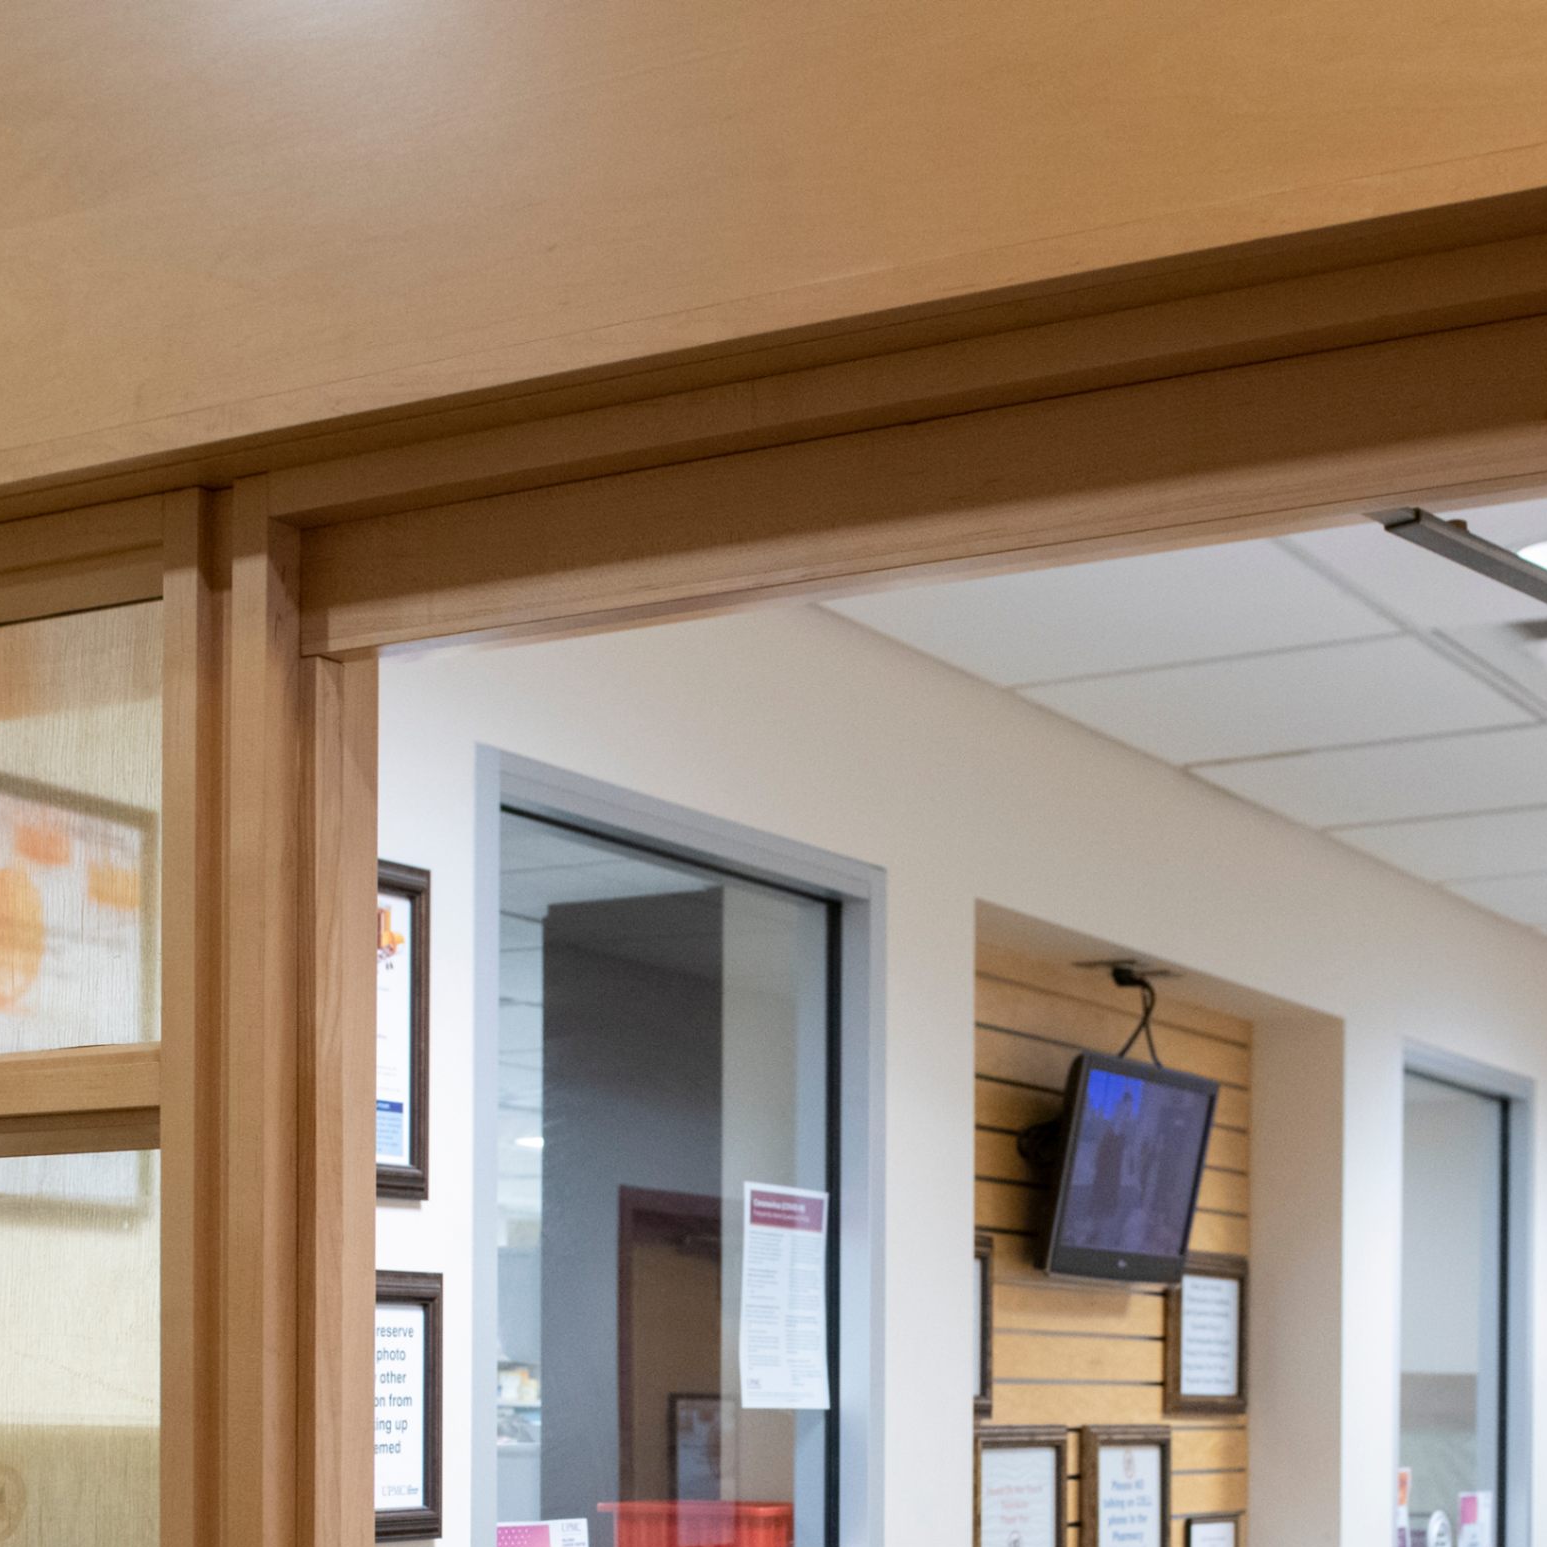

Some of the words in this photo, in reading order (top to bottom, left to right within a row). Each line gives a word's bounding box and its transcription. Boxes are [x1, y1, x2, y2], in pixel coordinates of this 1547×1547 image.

[377, 1348, 406, 1362] photo
[380, 1372, 407, 1384] other
[389, 1394, 412, 1406] from
[395, 1420, 407, 1432] up
